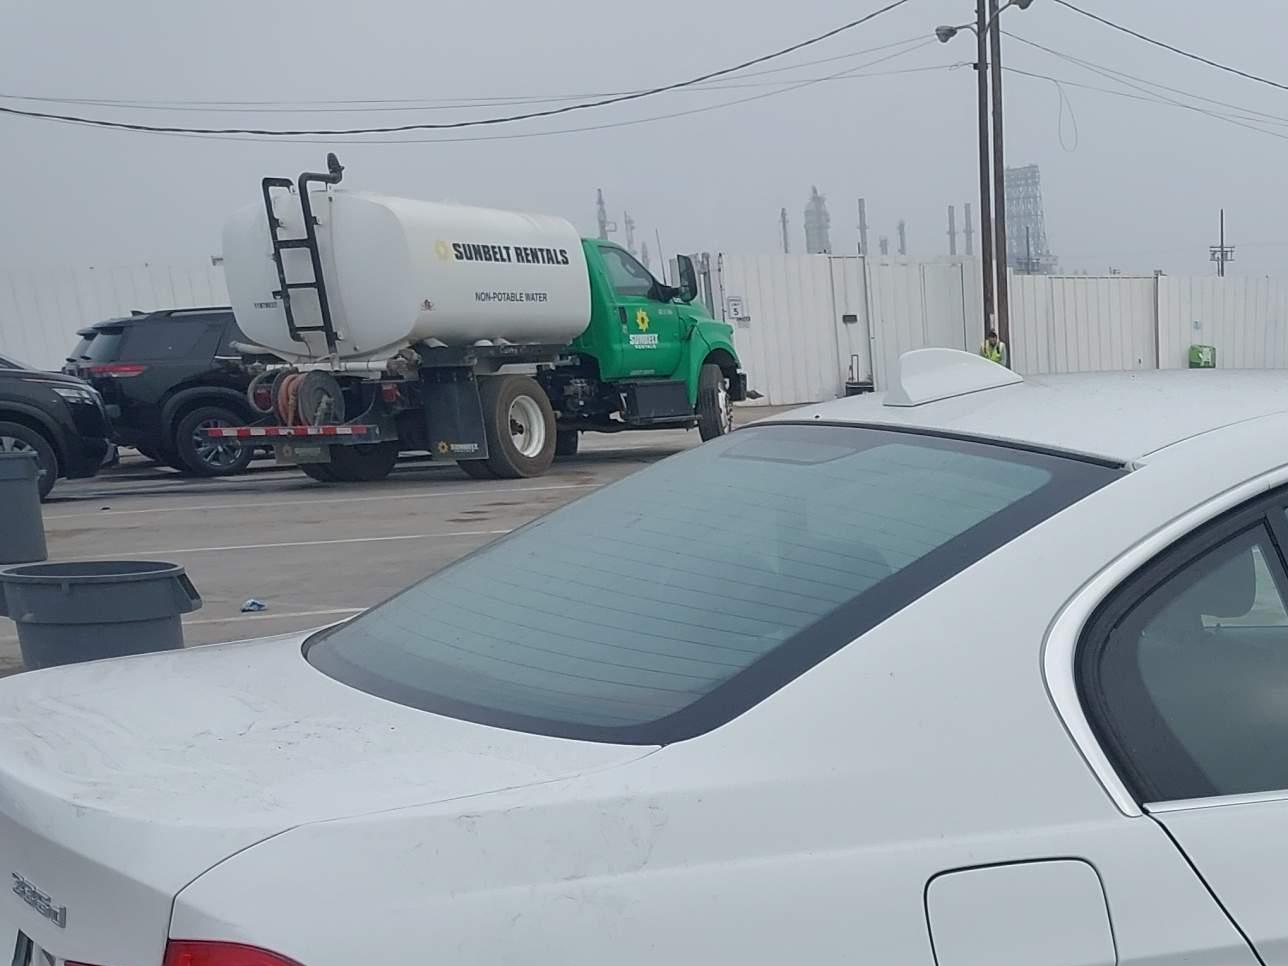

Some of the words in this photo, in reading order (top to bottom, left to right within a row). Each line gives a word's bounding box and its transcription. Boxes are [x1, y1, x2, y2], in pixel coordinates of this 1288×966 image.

[452, 243, 512, 263] SUNBELT
[513, 246, 569, 265] RENTALS
[475, 291, 524, 302] NON-POTABLE
[525, 292, 548, 302] WATER
